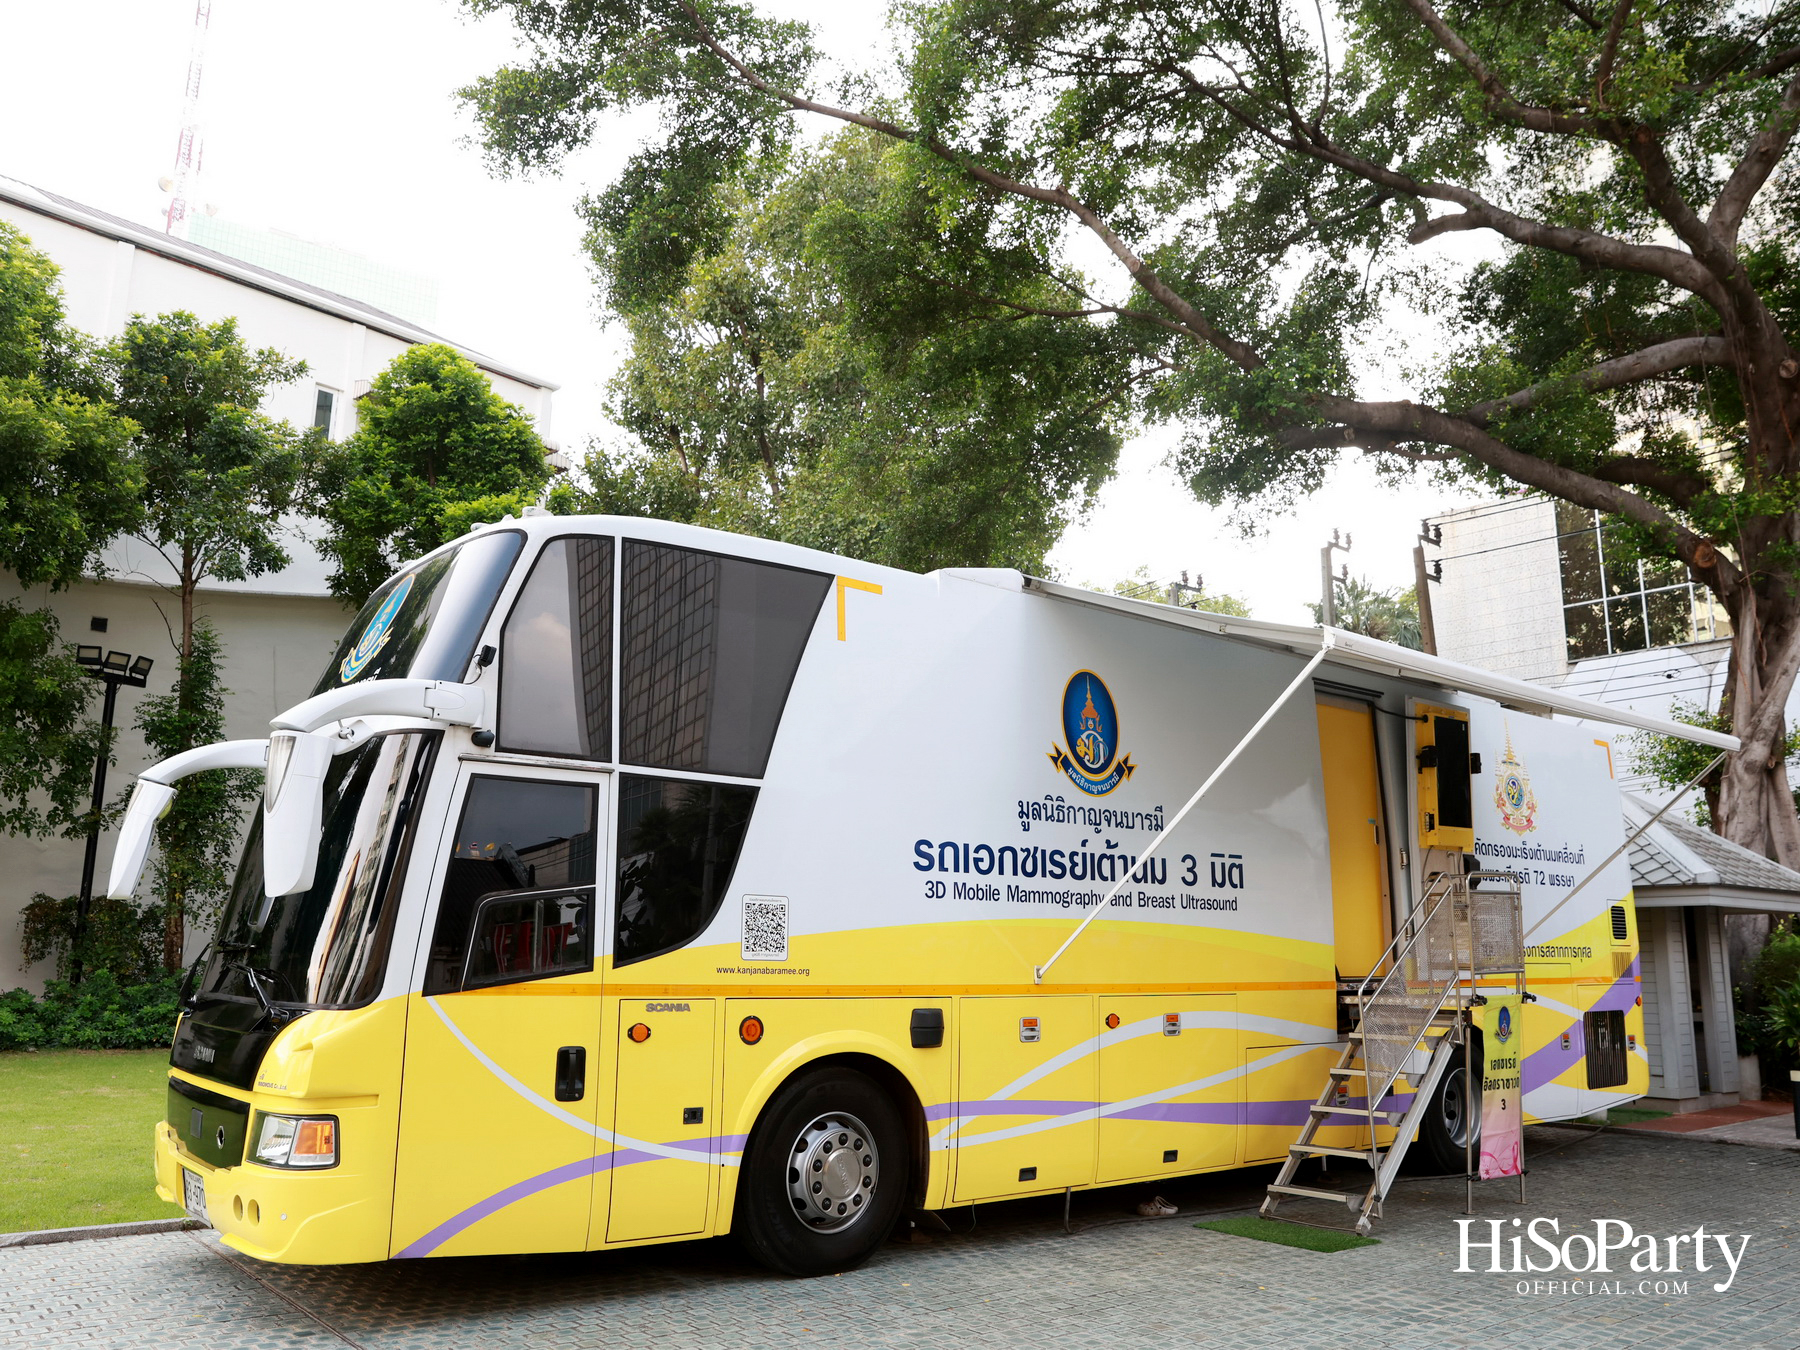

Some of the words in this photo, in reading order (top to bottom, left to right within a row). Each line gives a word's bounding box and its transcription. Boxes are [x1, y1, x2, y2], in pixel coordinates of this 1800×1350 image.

[1018, 795, 1164, 834] มูลนิธิกาญจนบารมี
[913, 838, 1167, 885] รถเอกซเรย์เต้านม
[1181, 855, 1198, 886] 3
[1210, 853, 1245, 889] มิติ
[1533, 870, 1546, 885] 72
[1548, 873, 1576, 888] พรรษา
[924, 880, 947, 900] 3D
[953, 881, 1001, 902] Mobile
[1007, 884, 1105, 909] Mammography
[1110, 891, 1132, 908] and
[1138, 891, 1176, 909] Breast
[1180, 893, 1238, 912] Ultrasound
[716, 965, 810, 977] www.kanjanabaramee.org
[645, 1003, 691, 1012] SCANIA
[1501, 1098, 1507, 1111] 3
